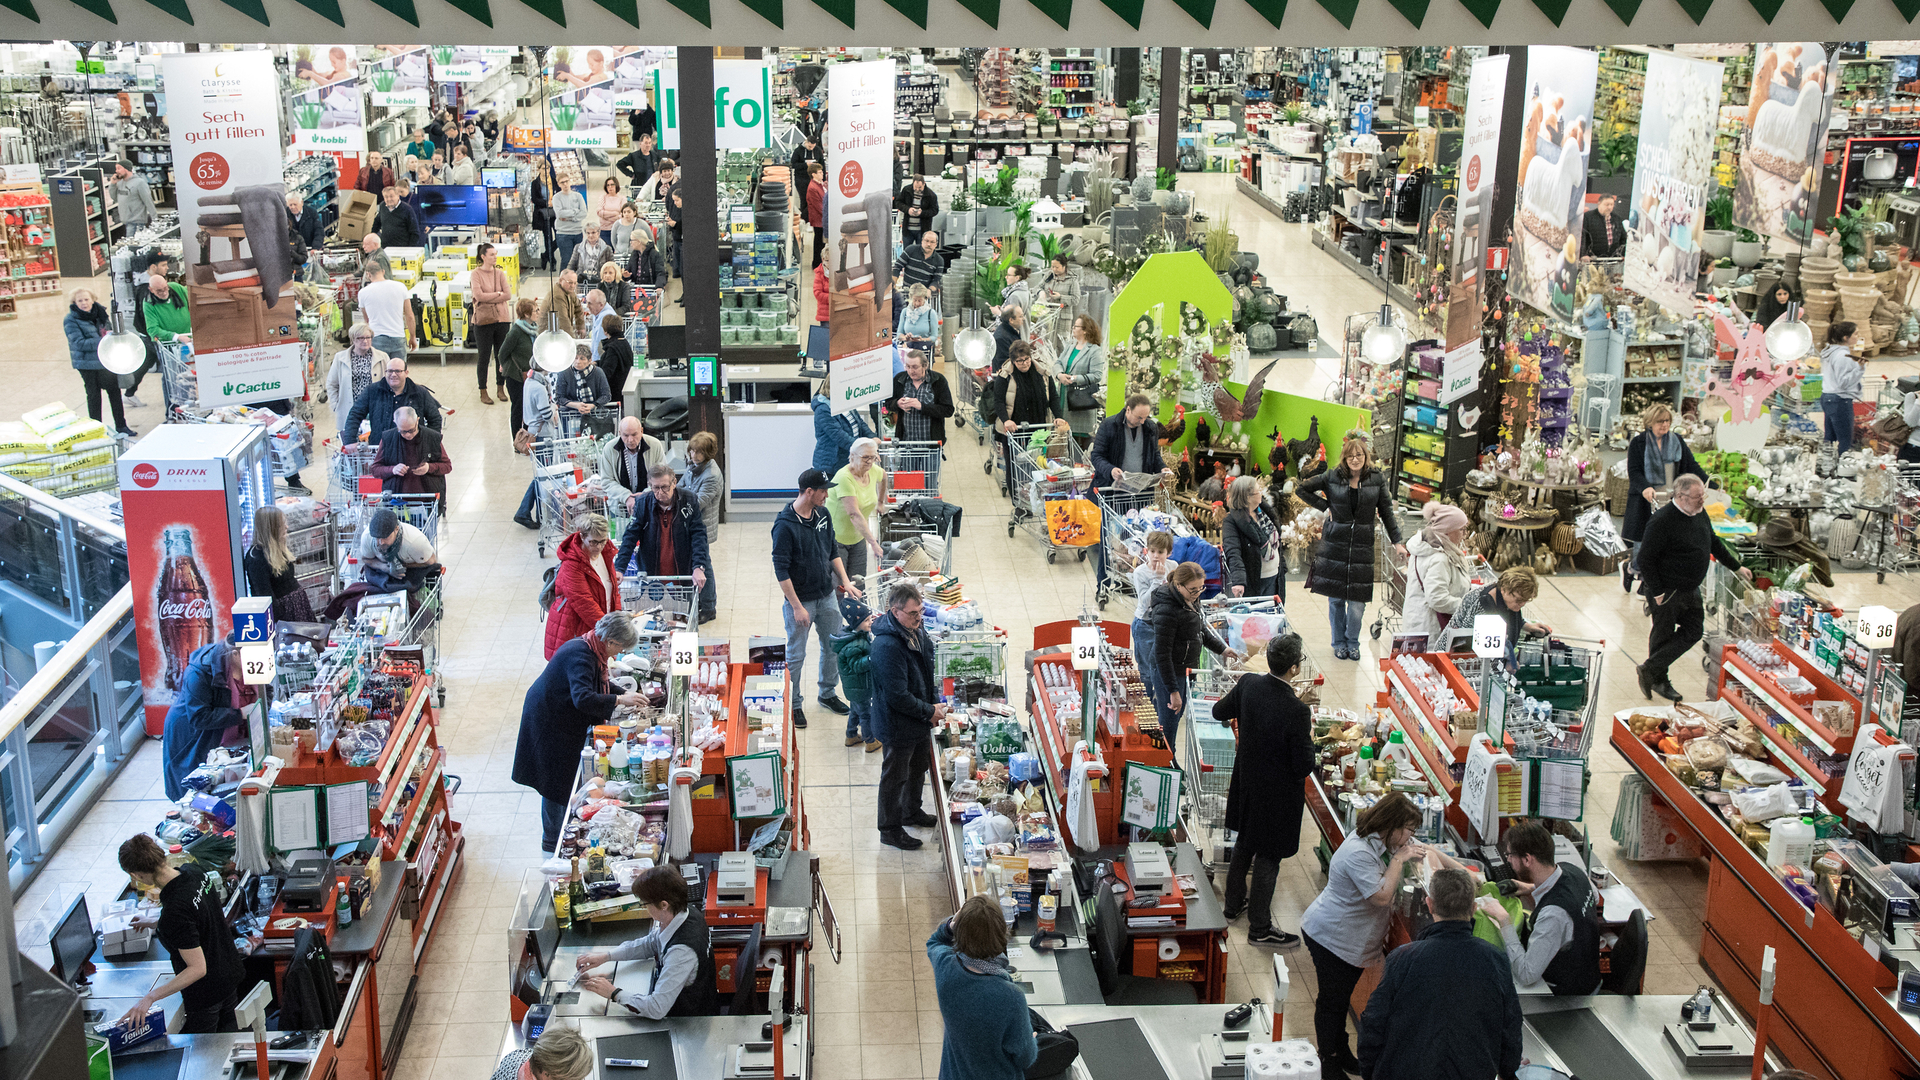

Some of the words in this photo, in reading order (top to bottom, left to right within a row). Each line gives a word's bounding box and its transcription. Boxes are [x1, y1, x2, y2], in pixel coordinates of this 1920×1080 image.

[201, 80, 241, 88] Clarysse
[666, 86, 762, 128] Ifo
[202, 110, 244, 124] Sech
[1478, 114, 1492, 128] Sech
[850, 118, 876, 132] Sech
[185, 128, 220, 144] gutt
[226, 126, 265, 138] fillen
[320, 136, 348, 144] hobbi
[575, 136, 602, 145] hobbi
[838, 137, 860, 154] gutt
[863, 134, 886, 146] fillen
[1640, 142, 1672, 174] SCHÉIN
[218, 358, 249, 367] biologique
[256, 354, 282, 362] Fairtrade
[236, 380, 281, 394] Cactus
[1455, 376, 1472, 390] Cactus
[853, 383, 880, 398] Cactus
[0, 442, 24, 450] CTISEL
[58, 433, 86, 446] ACTISEL
[63, 458, 91, 471] ACTISEL
[132, 471, 158, 480] Coca-Cola
[167, 468, 208, 476] DRINK
[160, 598, 212, 620] Coca-Cola
[1860, 619, 1870, 636] 36
[1876, 624, 1892, 638] 36
[1484, 636, 1500, 648] 35
[676, 652, 692, 664] 33
[1079, 646, 1096, 659] 34
[246, 661, 264, 674] 32
[982, 742, 1018, 754] Volvic
[120, 1024, 150, 1044] Tempo
